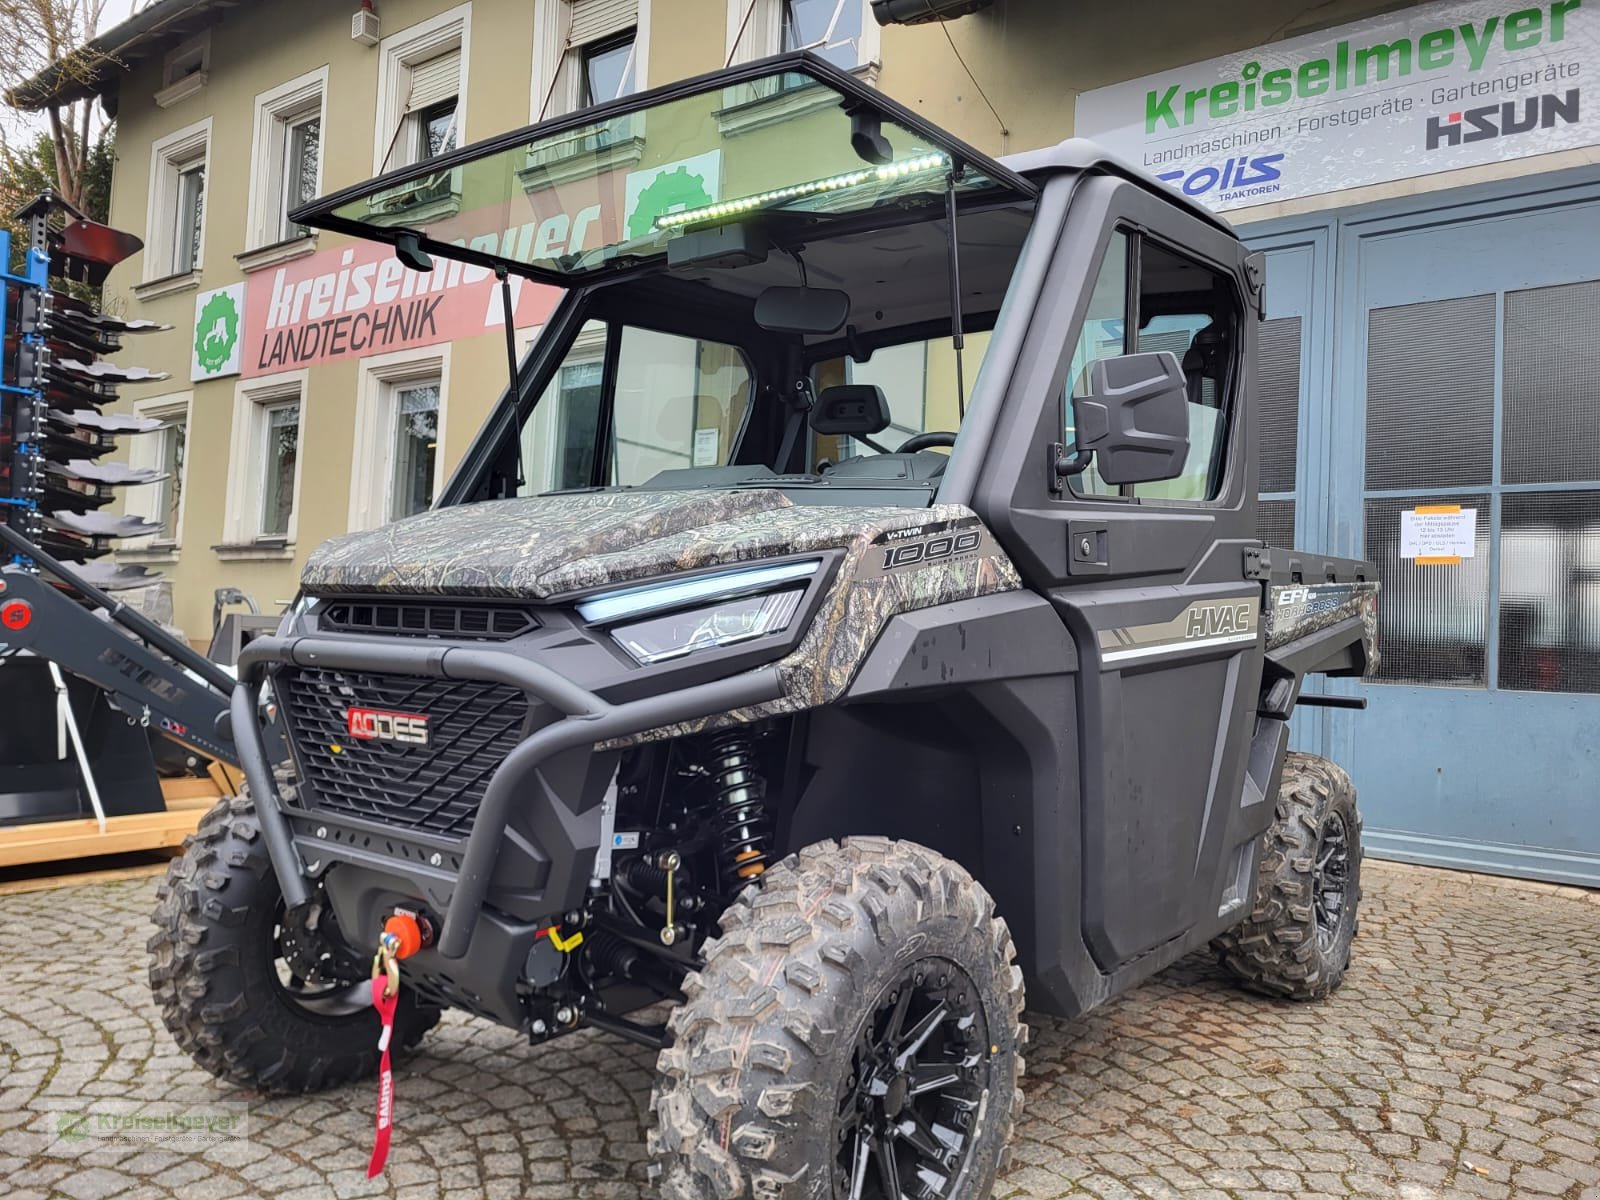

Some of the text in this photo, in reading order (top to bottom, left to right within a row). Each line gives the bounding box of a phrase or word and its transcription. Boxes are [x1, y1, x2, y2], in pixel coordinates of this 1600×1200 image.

[1145, 0, 1581, 134] Kreiselmeyer
[1144, 62, 1581, 166] Landmaschinen Forstgeräte Gartengeräte
[1219, 184, 1280, 201] TRAKTOREN
[258, 295, 445, 370] LANDTECHNIK
[882, 530, 981, 570] 1000
[887, 527, 922, 540] V-TWIN
[1278, 589, 1309, 606] EFI
[1185, 604, 1250, 638] HVAC
[352, 711, 428, 744] AODES
